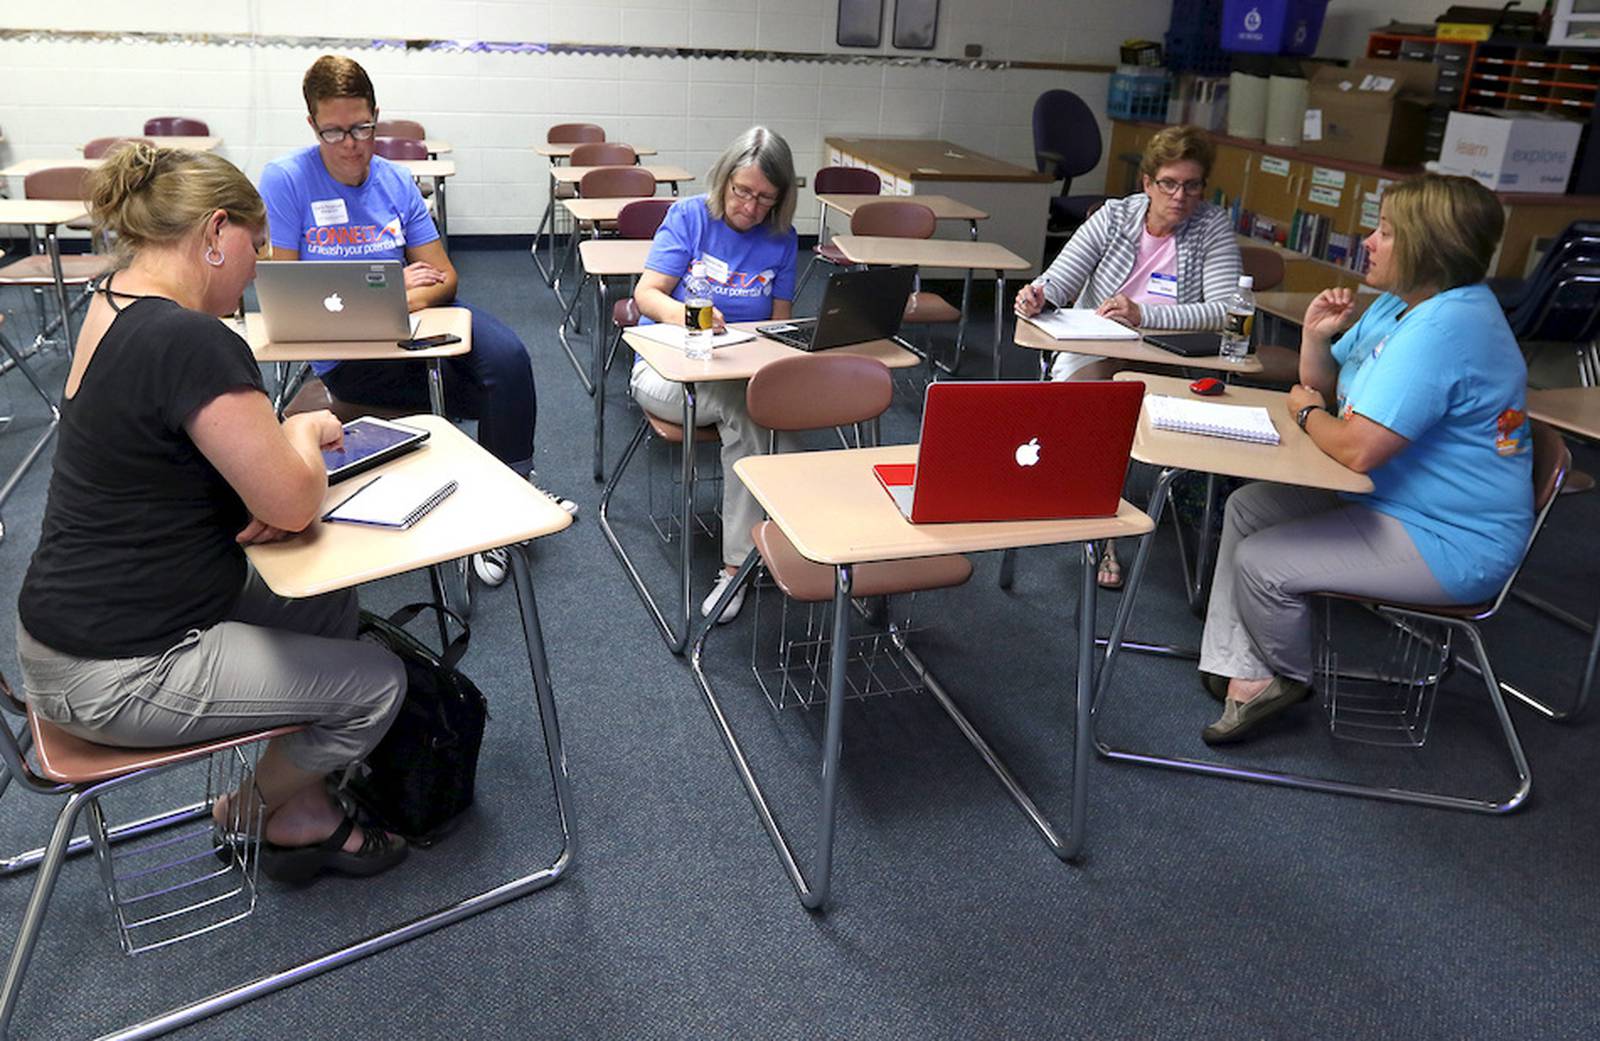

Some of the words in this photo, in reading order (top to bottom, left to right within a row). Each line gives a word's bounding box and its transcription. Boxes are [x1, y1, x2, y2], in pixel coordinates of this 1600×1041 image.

[1456, 137, 1488, 157] learn
[1513, 148, 1567, 163] explore
[306, 226, 377, 245] CONNECT
[308, 244, 343, 255] unleash
[343, 243, 362, 257] your
[363, 239, 396, 255] potential
[729, 286, 762, 296] potential
